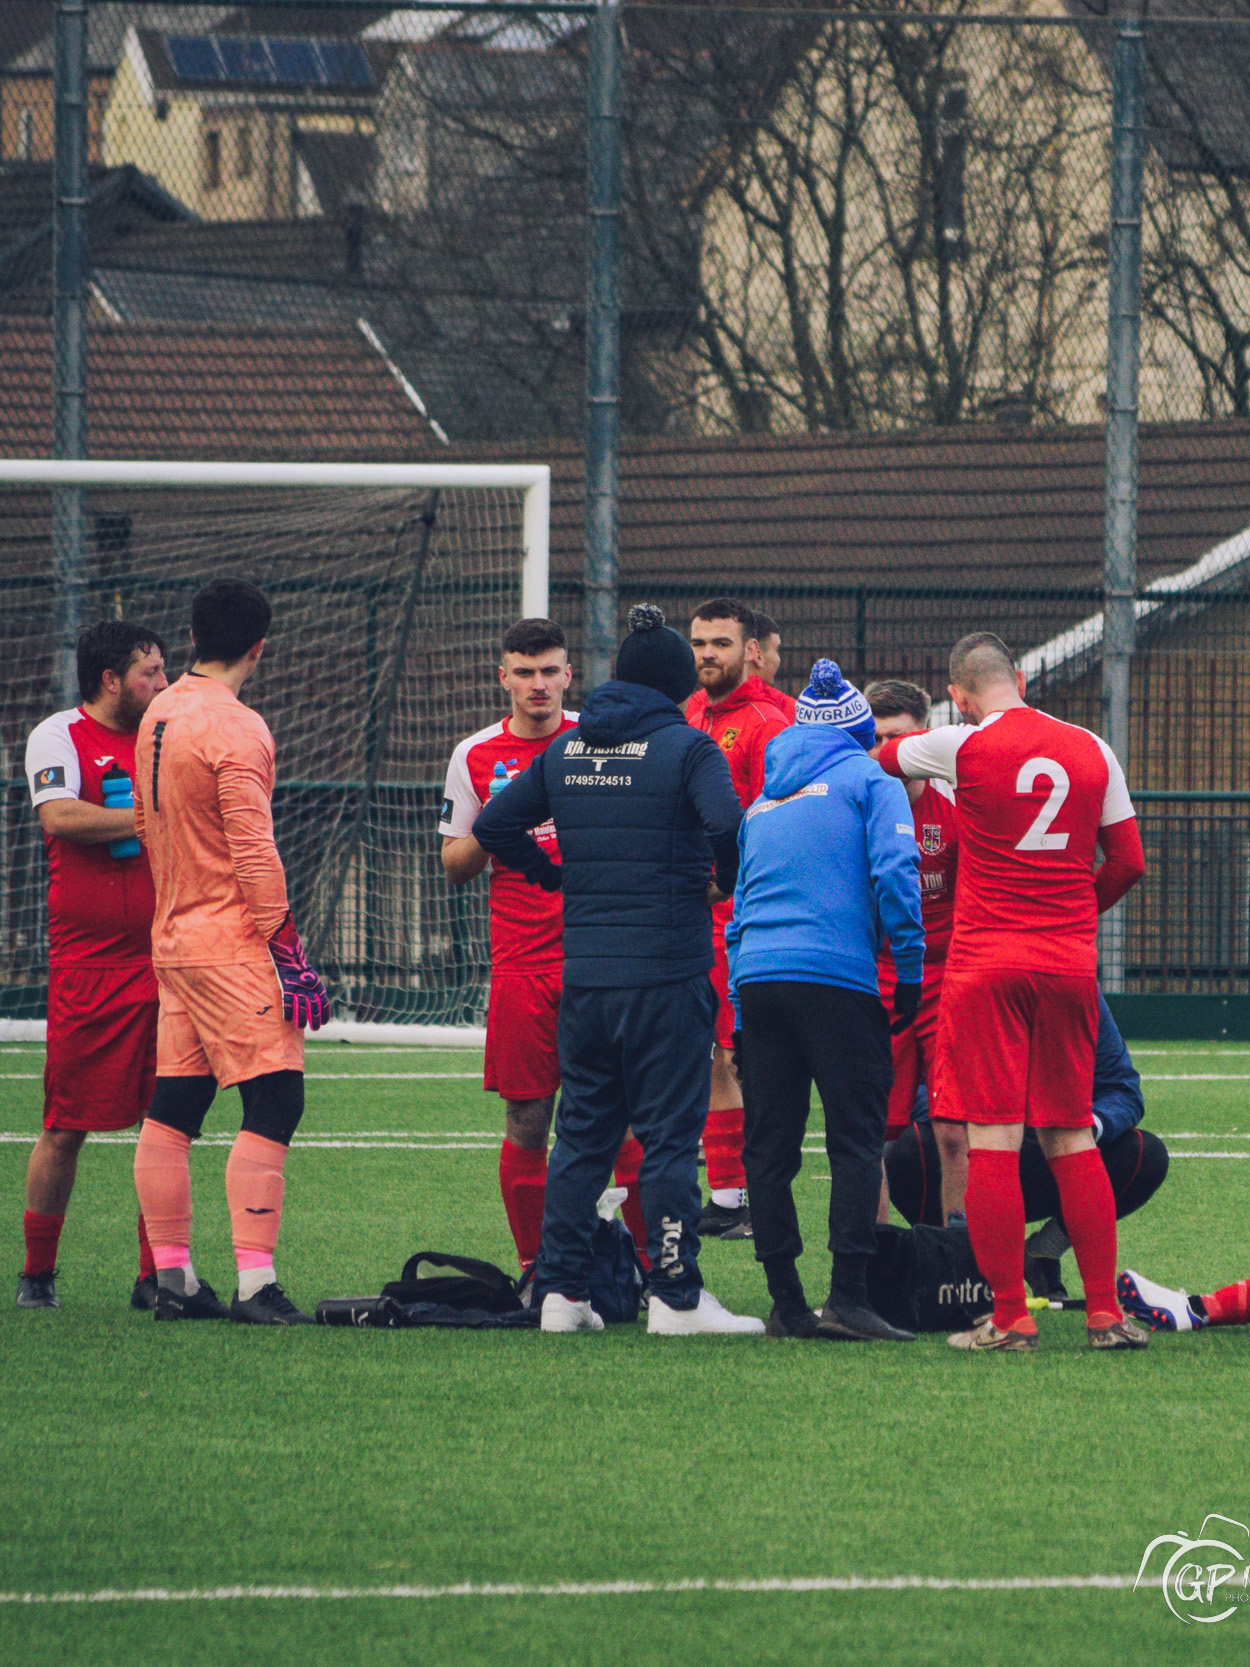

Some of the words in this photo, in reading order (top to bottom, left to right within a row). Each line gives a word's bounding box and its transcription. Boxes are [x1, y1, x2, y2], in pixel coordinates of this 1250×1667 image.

[796, 700, 863, 721] PENYGRAIG
[152, 721, 167, 812] 1
[565, 775, 632, 786] 07495724513
[1014, 757, 1070, 850] 2
[660, 1216, 684, 1278] Joma
